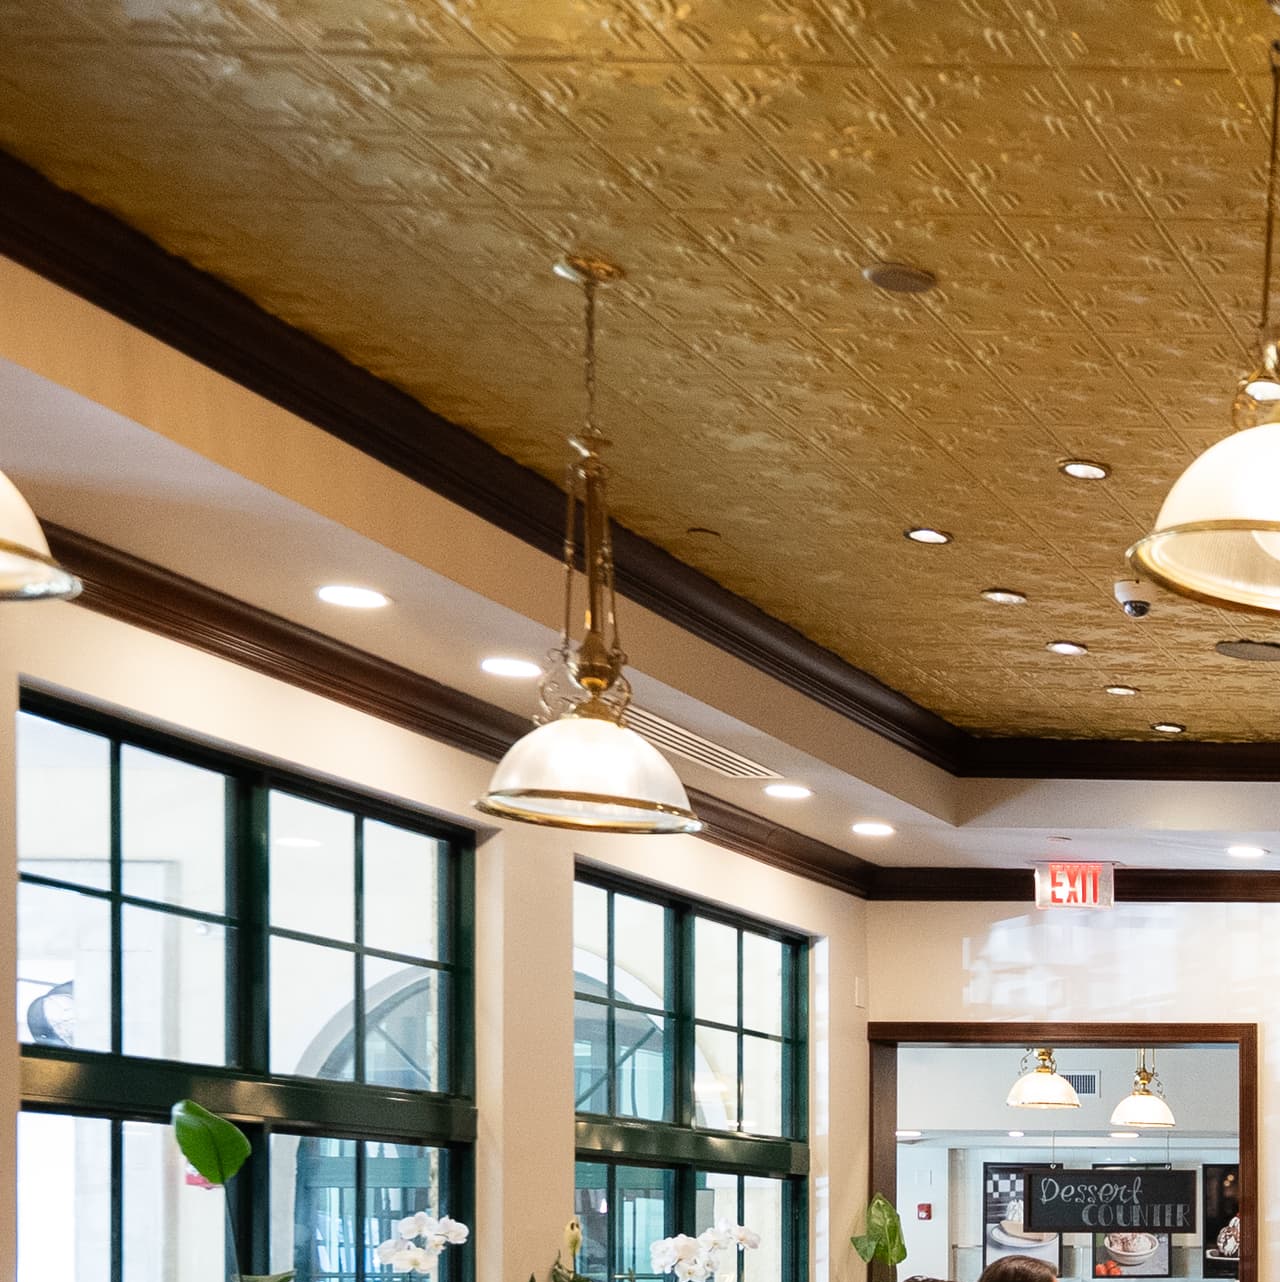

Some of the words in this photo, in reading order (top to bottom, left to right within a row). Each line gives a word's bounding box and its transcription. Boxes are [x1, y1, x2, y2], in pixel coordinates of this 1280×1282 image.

[1049, 864, 1102, 903] EXIT
[1040, 1176, 1143, 1205] Dessert
[1082, 1203, 1191, 1228] COUNTER
